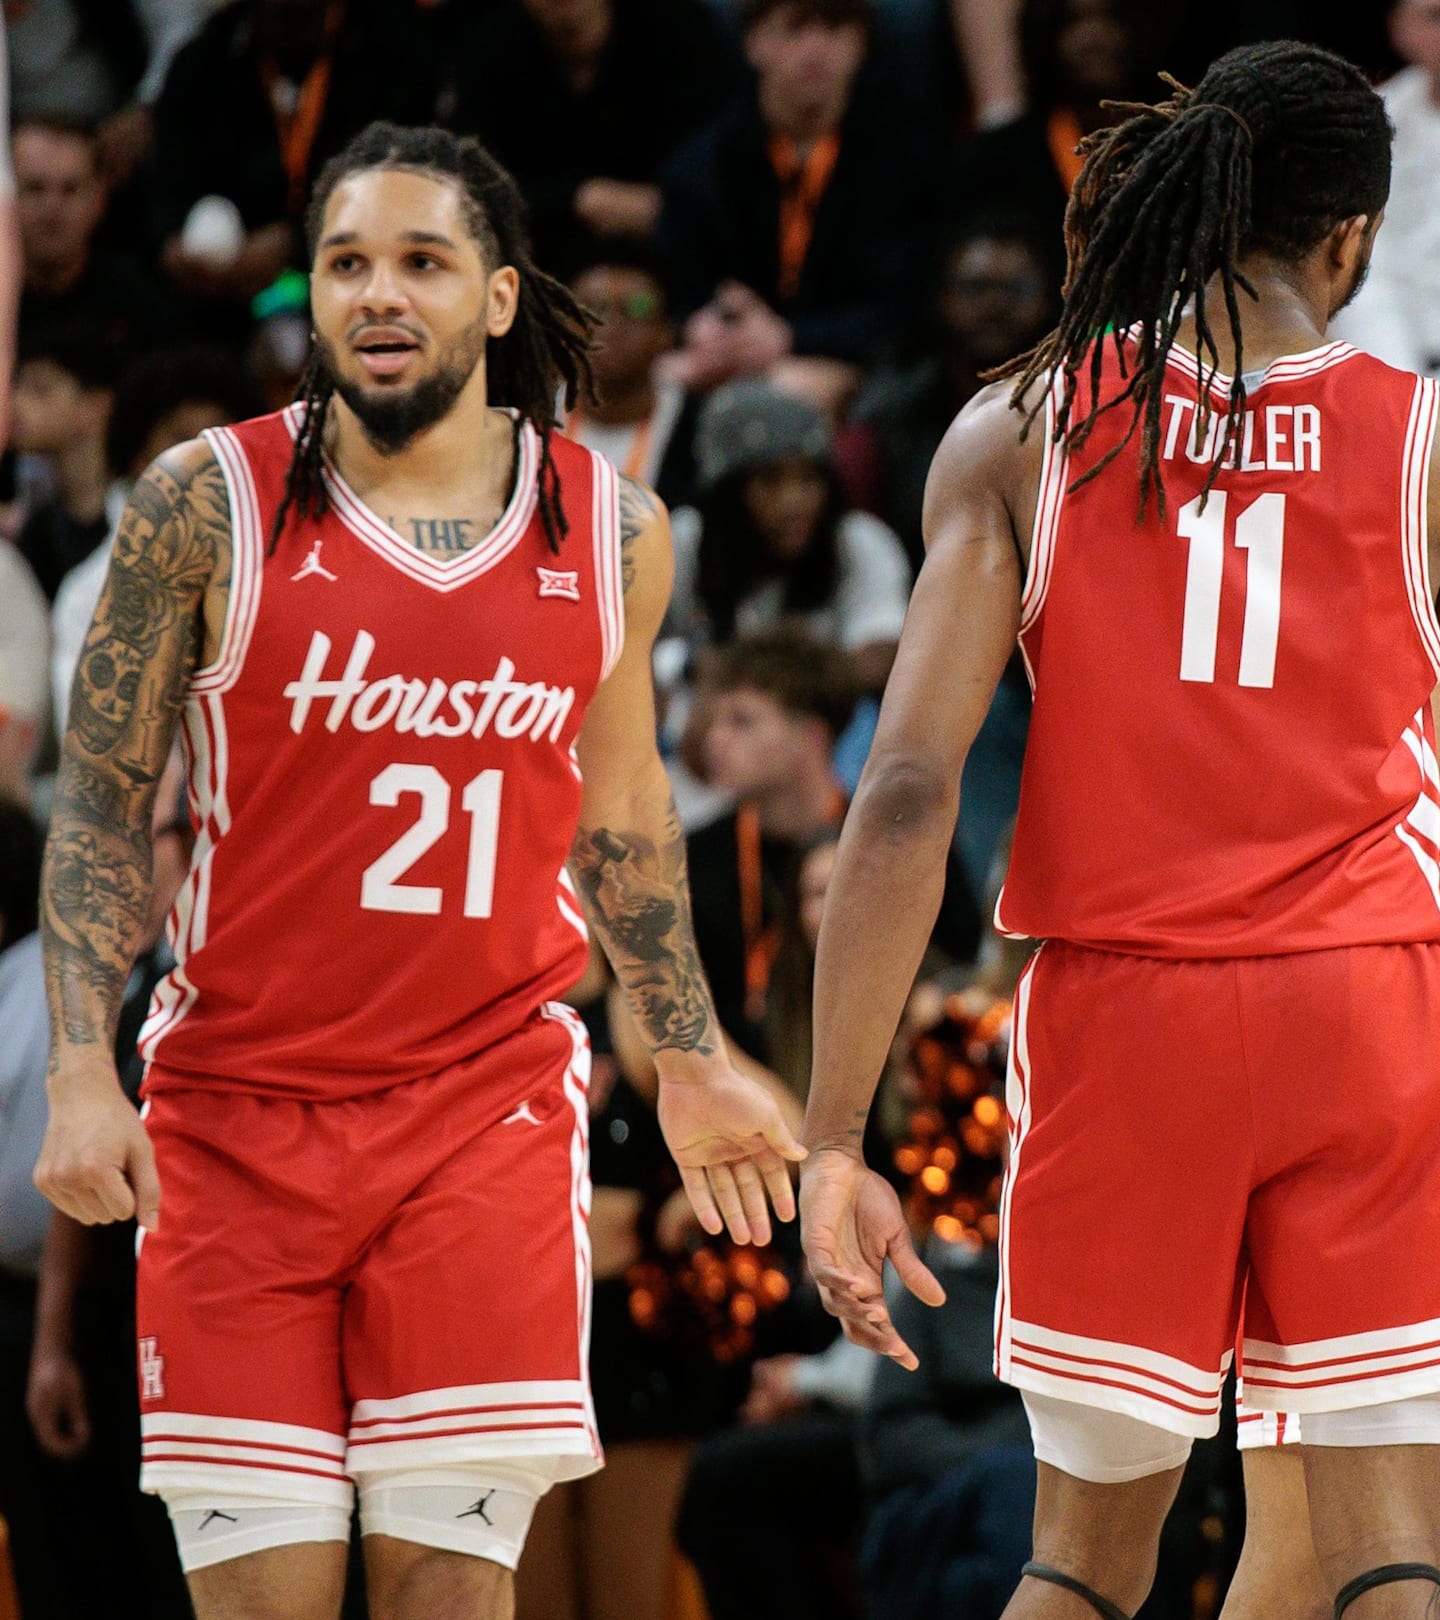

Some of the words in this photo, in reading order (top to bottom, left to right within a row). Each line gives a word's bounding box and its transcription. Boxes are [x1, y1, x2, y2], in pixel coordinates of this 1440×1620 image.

[410, 518, 473, 551] THE
[1176, 489, 1286, 688] 11
[282, 629, 576, 744] Houston
[360, 763, 504, 918] 21
